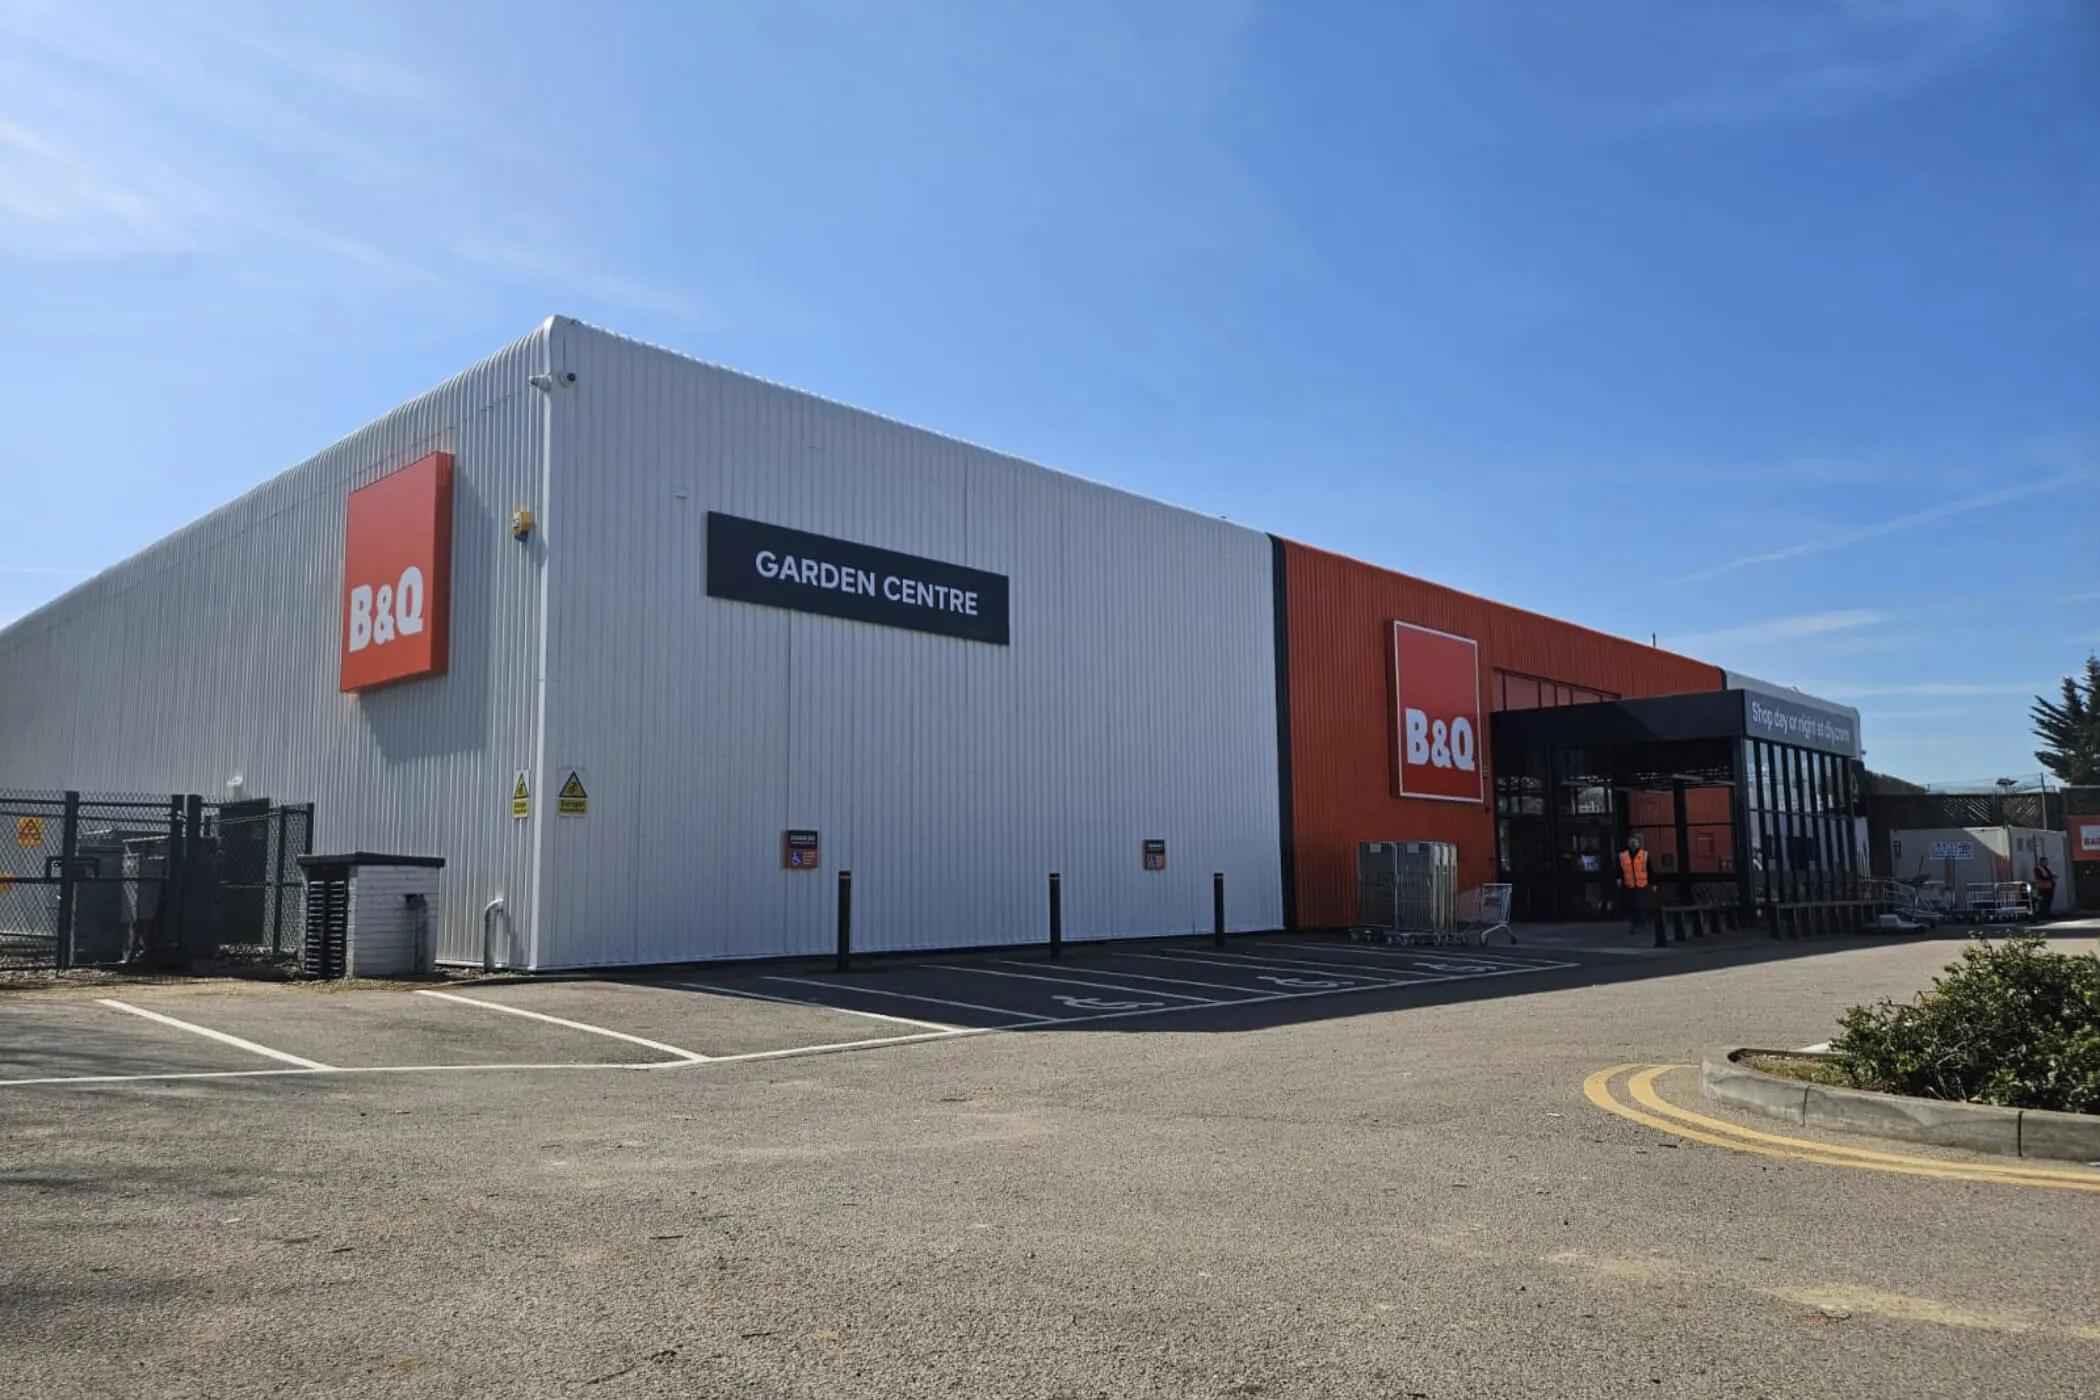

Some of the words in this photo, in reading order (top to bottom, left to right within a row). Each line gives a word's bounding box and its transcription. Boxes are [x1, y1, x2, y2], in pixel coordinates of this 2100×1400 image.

[348, 565, 424, 653] B&Q
[755, 550, 876, 597] GARDEN
[883, 576, 979, 616] CENTRE
[1405, 707, 1475, 772] B&Q
[1751, 701, 1773, 731] Shop
[1774, 706, 1788, 735] day
[1789, 715, 1797, 731] or
[1798, 713, 1816, 739] night
